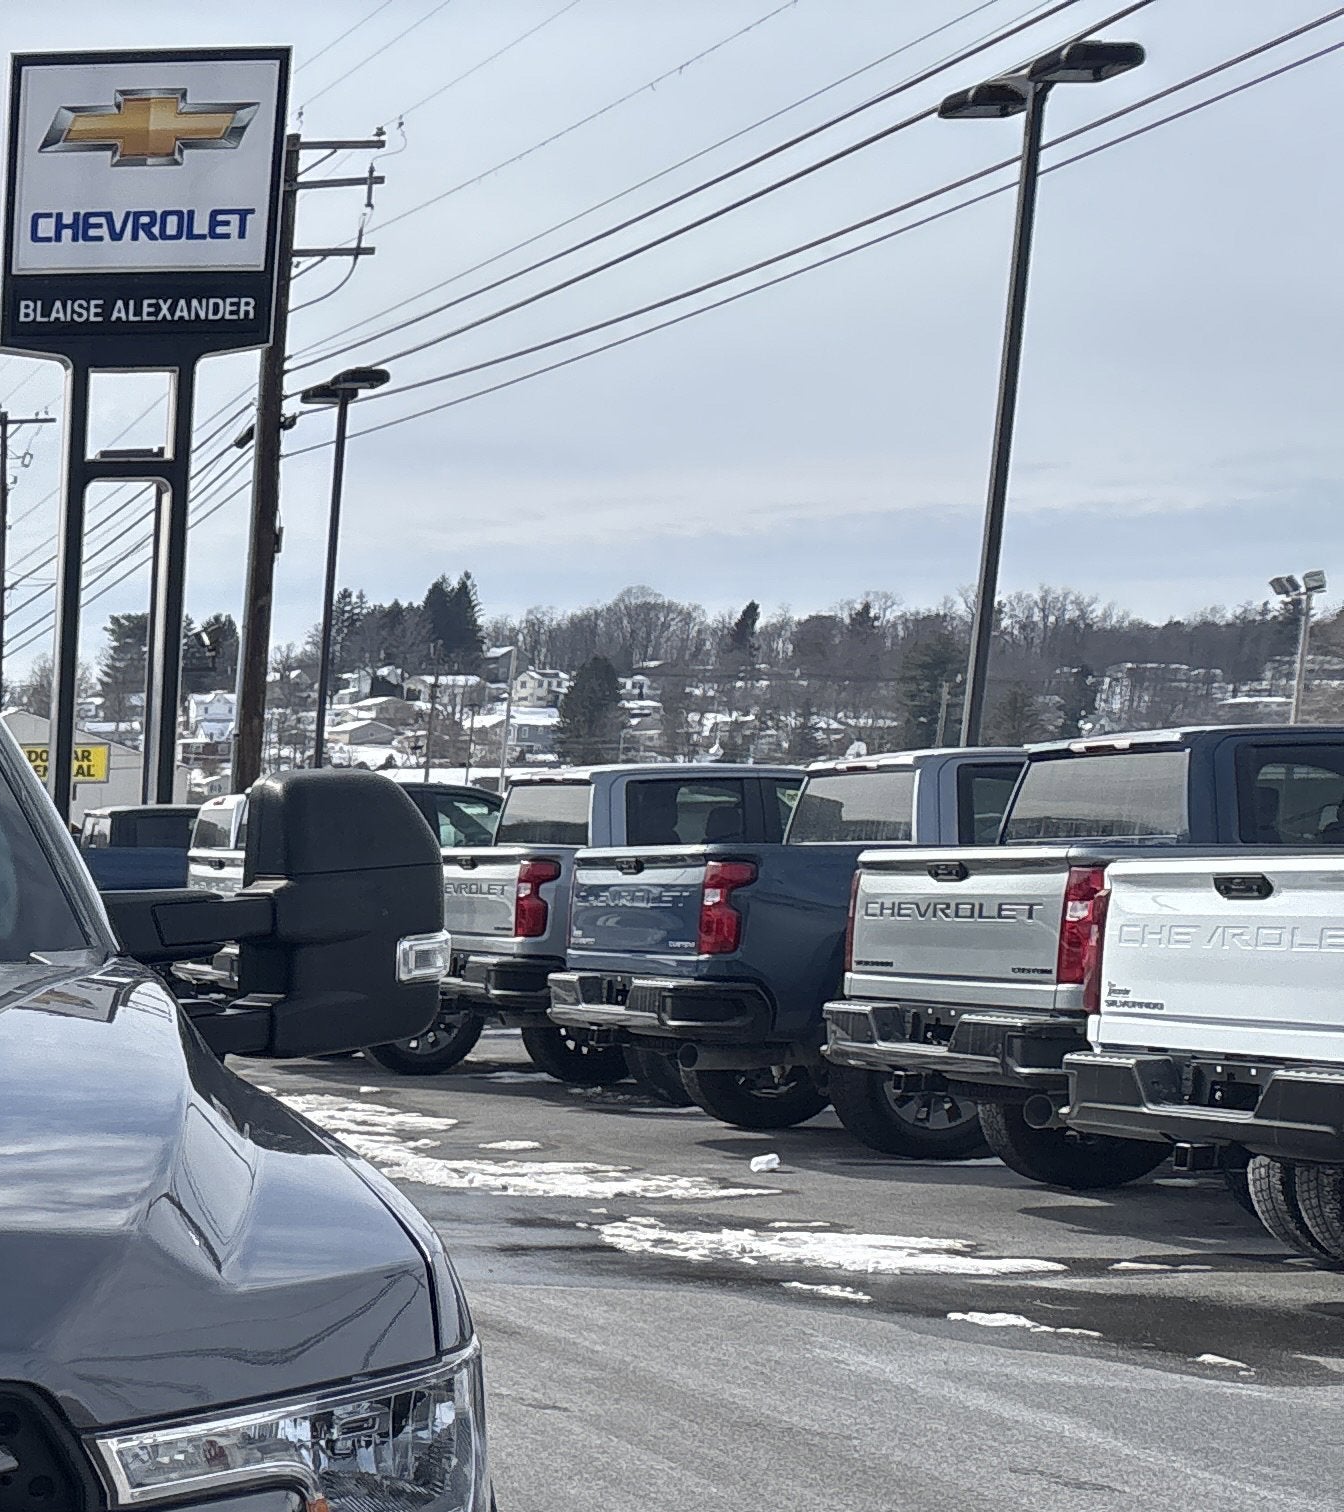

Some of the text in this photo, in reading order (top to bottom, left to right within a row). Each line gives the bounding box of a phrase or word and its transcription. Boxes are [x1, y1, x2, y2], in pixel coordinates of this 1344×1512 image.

[30, 208, 255, 243] CHEVROLET
[19, 298, 255, 322] BLAISE ALEXANDER
[26, 749, 92, 762] DOAR
[864, 902, 1044, 922] CHEVROLET
[1118, 923, 1344, 953] CHEVROLE
